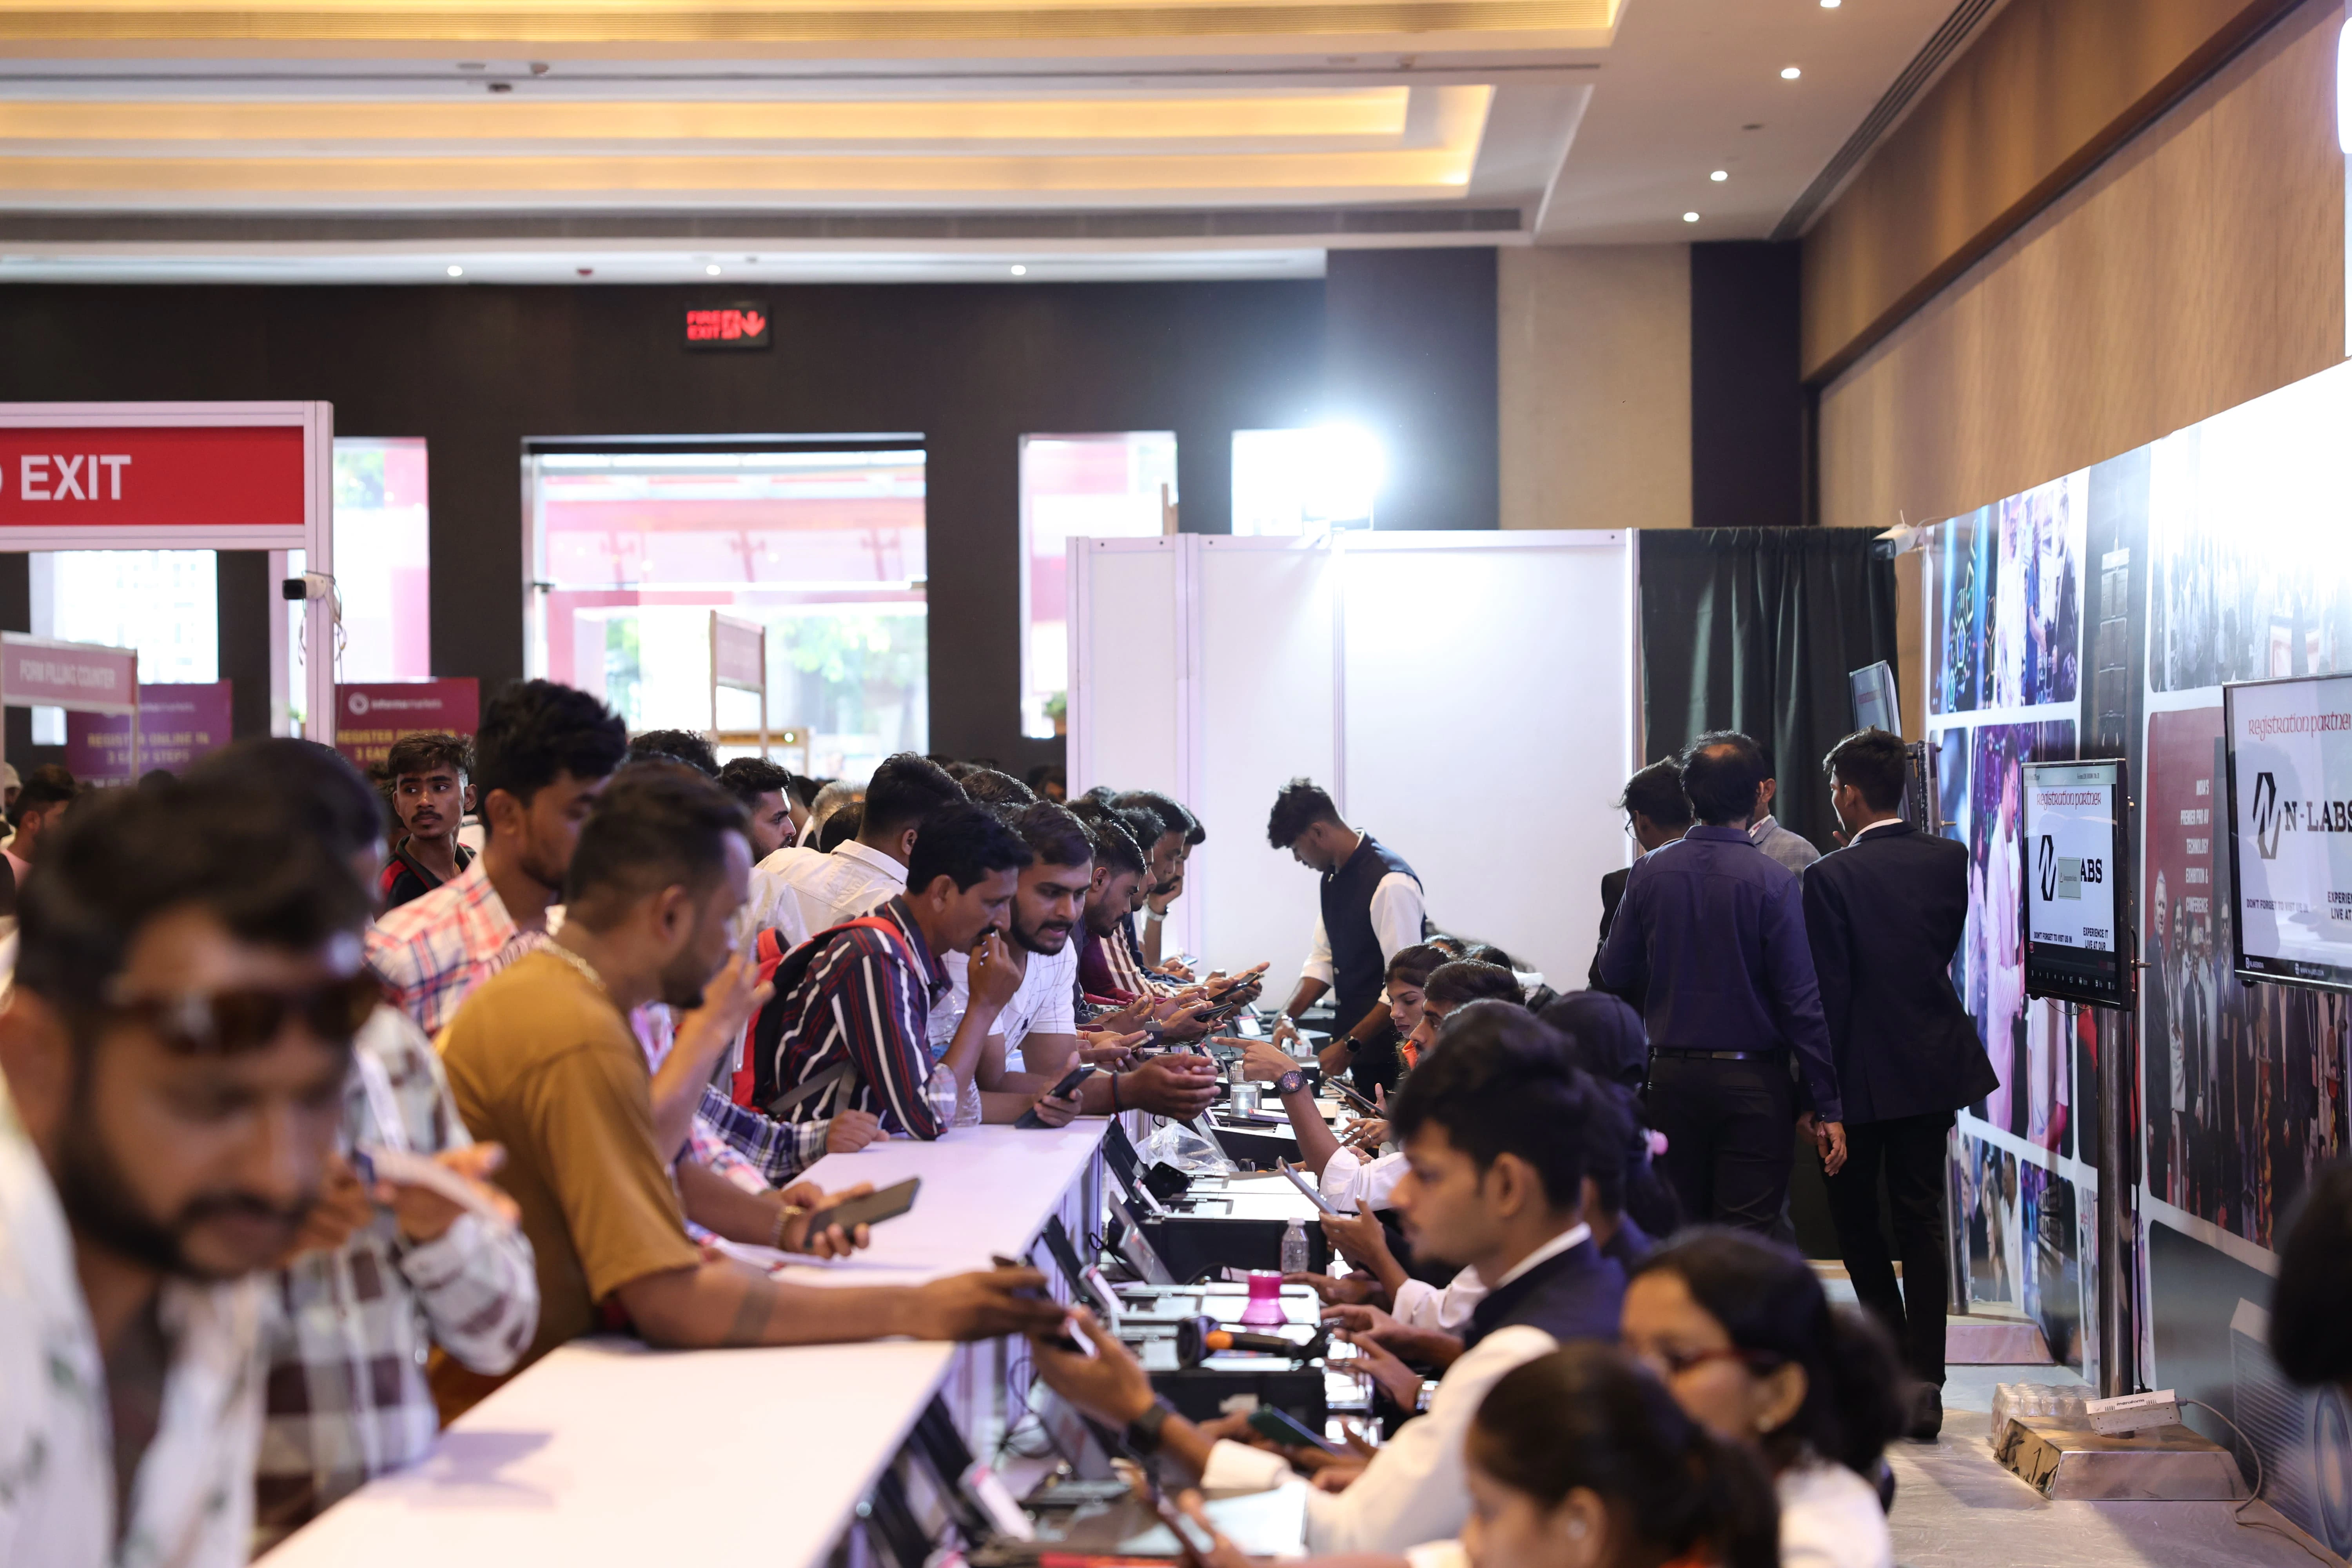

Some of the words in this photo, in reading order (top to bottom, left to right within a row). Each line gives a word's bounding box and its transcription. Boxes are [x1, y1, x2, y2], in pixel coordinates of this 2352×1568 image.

[21, 454, 132, 501] EXIT
[2187, 838, 2209, 855] TECHNOLOGY
[2330, 907, 2343, 920] LIVE
[2345, 908, 2352, 921] AT
[2043, 933, 2053, 941] FORGET
[2083, 927, 2104, 938] EXPERIENCE
[2105, 929, 2108, 938] IT
[2093, 941, 2098, 949] AT
